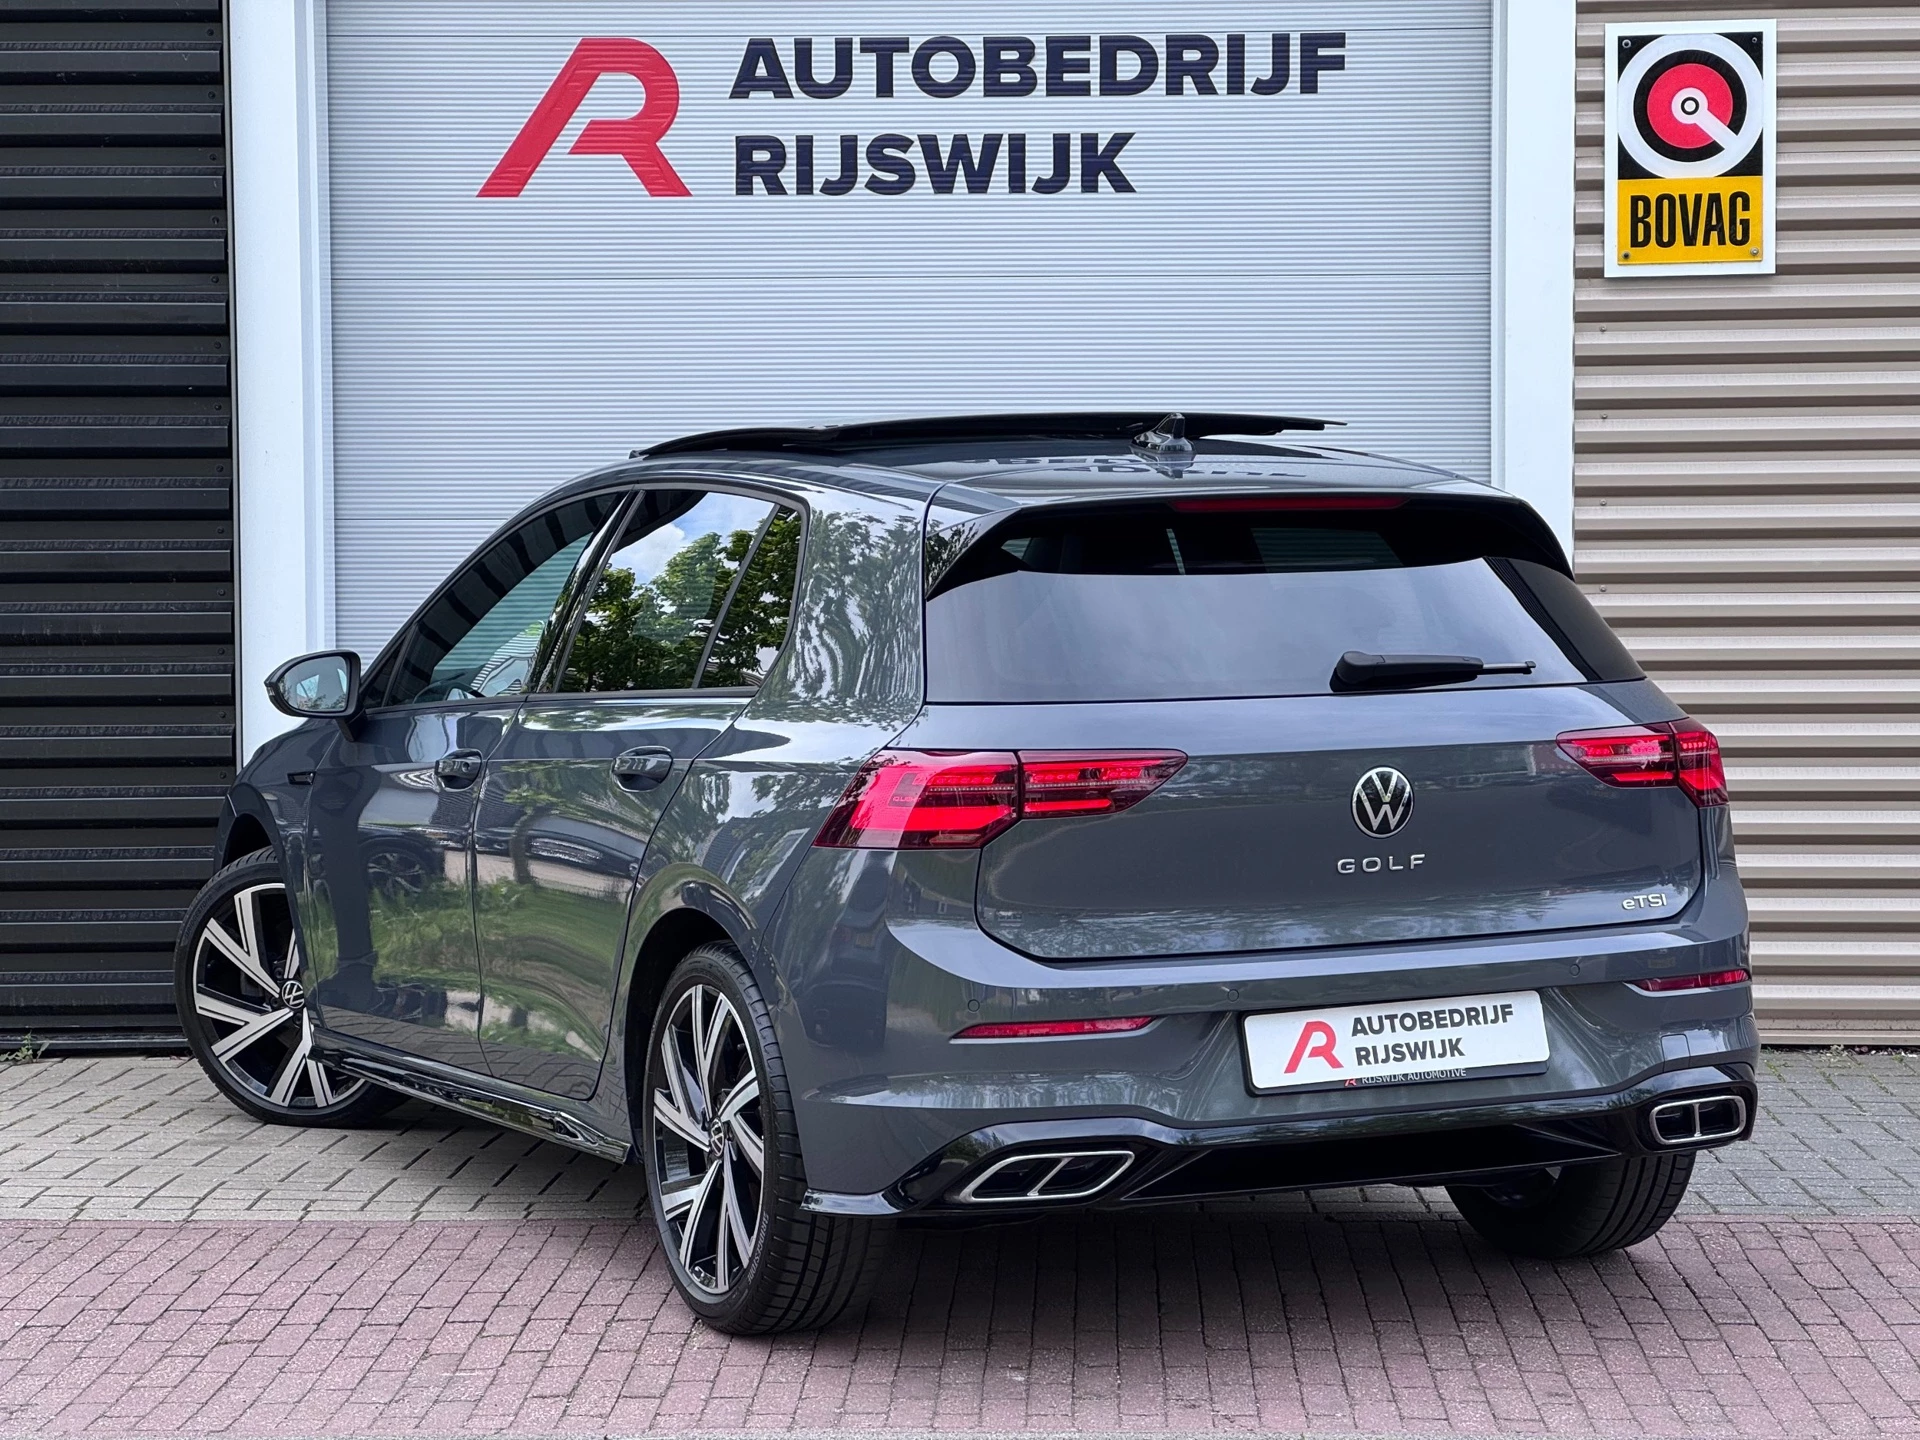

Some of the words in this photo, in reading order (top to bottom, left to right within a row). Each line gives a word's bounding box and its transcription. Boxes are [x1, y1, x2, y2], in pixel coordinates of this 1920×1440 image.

[729, 32, 1347, 100] AUTOBEDRIJF
[734, 132, 1136, 197] RIJSWIJK
[1630, 191, 1750, 249] BOVAG
[1352, 766, 1414, 838] VW
[1337, 853, 1426, 874] GOLF
[1621, 893, 1668, 911] eTSI
[1351, 1003, 1514, 1037] AUTOBEDRIJF
[1354, 1037, 1466, 1066] RIJSWIJK
[1407, 1068, 1467, 1081] AUTOMOTIVE
[747, 1210, 769, 1285] BRIDGESTONE
